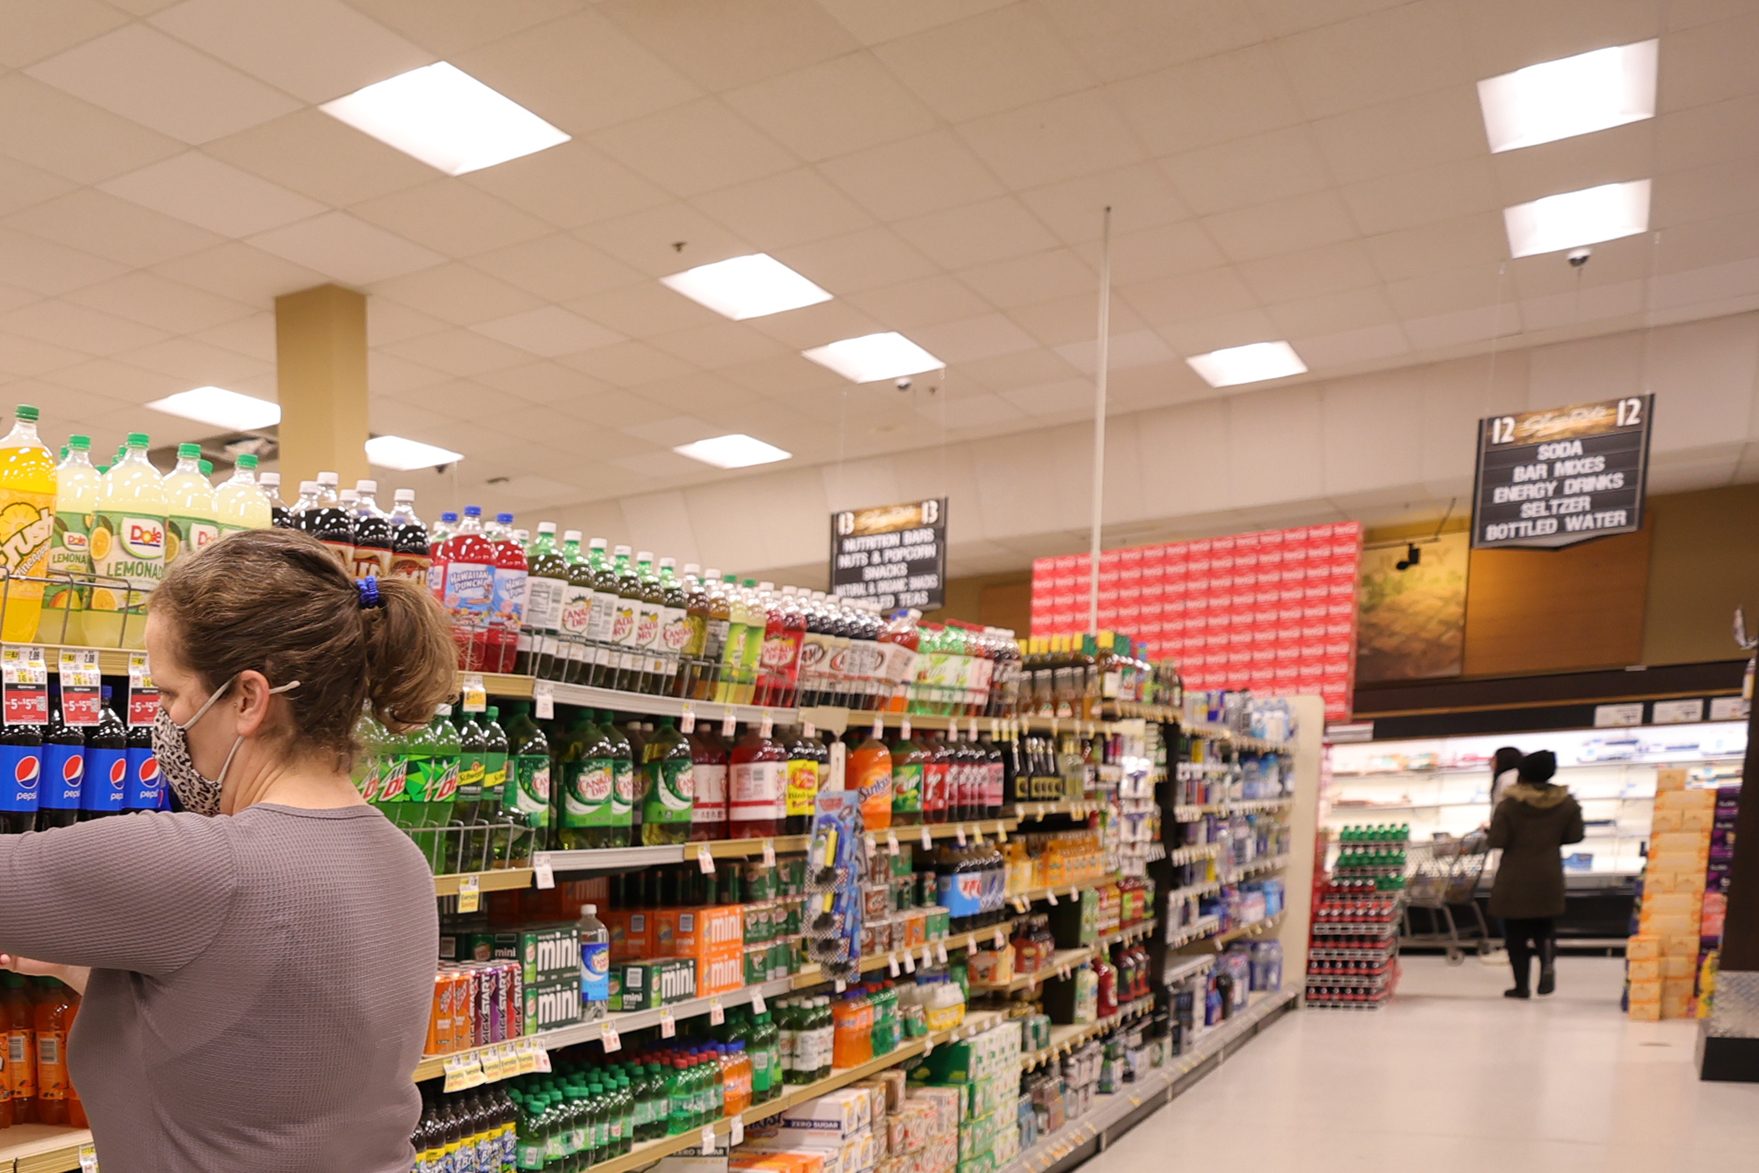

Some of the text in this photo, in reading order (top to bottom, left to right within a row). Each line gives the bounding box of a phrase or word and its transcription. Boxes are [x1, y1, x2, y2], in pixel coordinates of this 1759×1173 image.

[1492, 416, 1516, 444] 12
[1617, 398, 1642, 427] 12
[1537, 439, 1583, 460] SODA
[1513, 456, 1606, 483] BAR MIXES
[1493, 472, 1625, 504] ENERGY DRINKS
[1520, 495, 1591, 518] SELTZER
[838, 511, 855, 536] 13
[921, 500, 939, 525] 13
[1485, 510, 1627, 542] BOTTLED WATER
[67, 534, 87, 547] Dole
[130, 525, 162, 543] Dole
[842, 527, 935, 553] NUTRITION BARS
[837, 551, 869, 570] NUTS
[882, 542, 937, 563] POPCORN
[450, 569, 489, 583] HAWAIIAN
[862, 562, 908, 581] SNACKS
[454, 578, 484, 592] PUNCH
[898, 591, 929, 607] TEAS
[577, 775, 613, 793] CANADA
[591, 786, 611, 799] DRY
[16, 791, 38, 802] pepsi
[711, 911, 742, 944] mini
[495, 946, 517, 959] mini
[538, 929, 579, 974] mini
[661, 962, 696, 1000] mini
[791, 1120, 838, 1130] ZERO SUGAR
